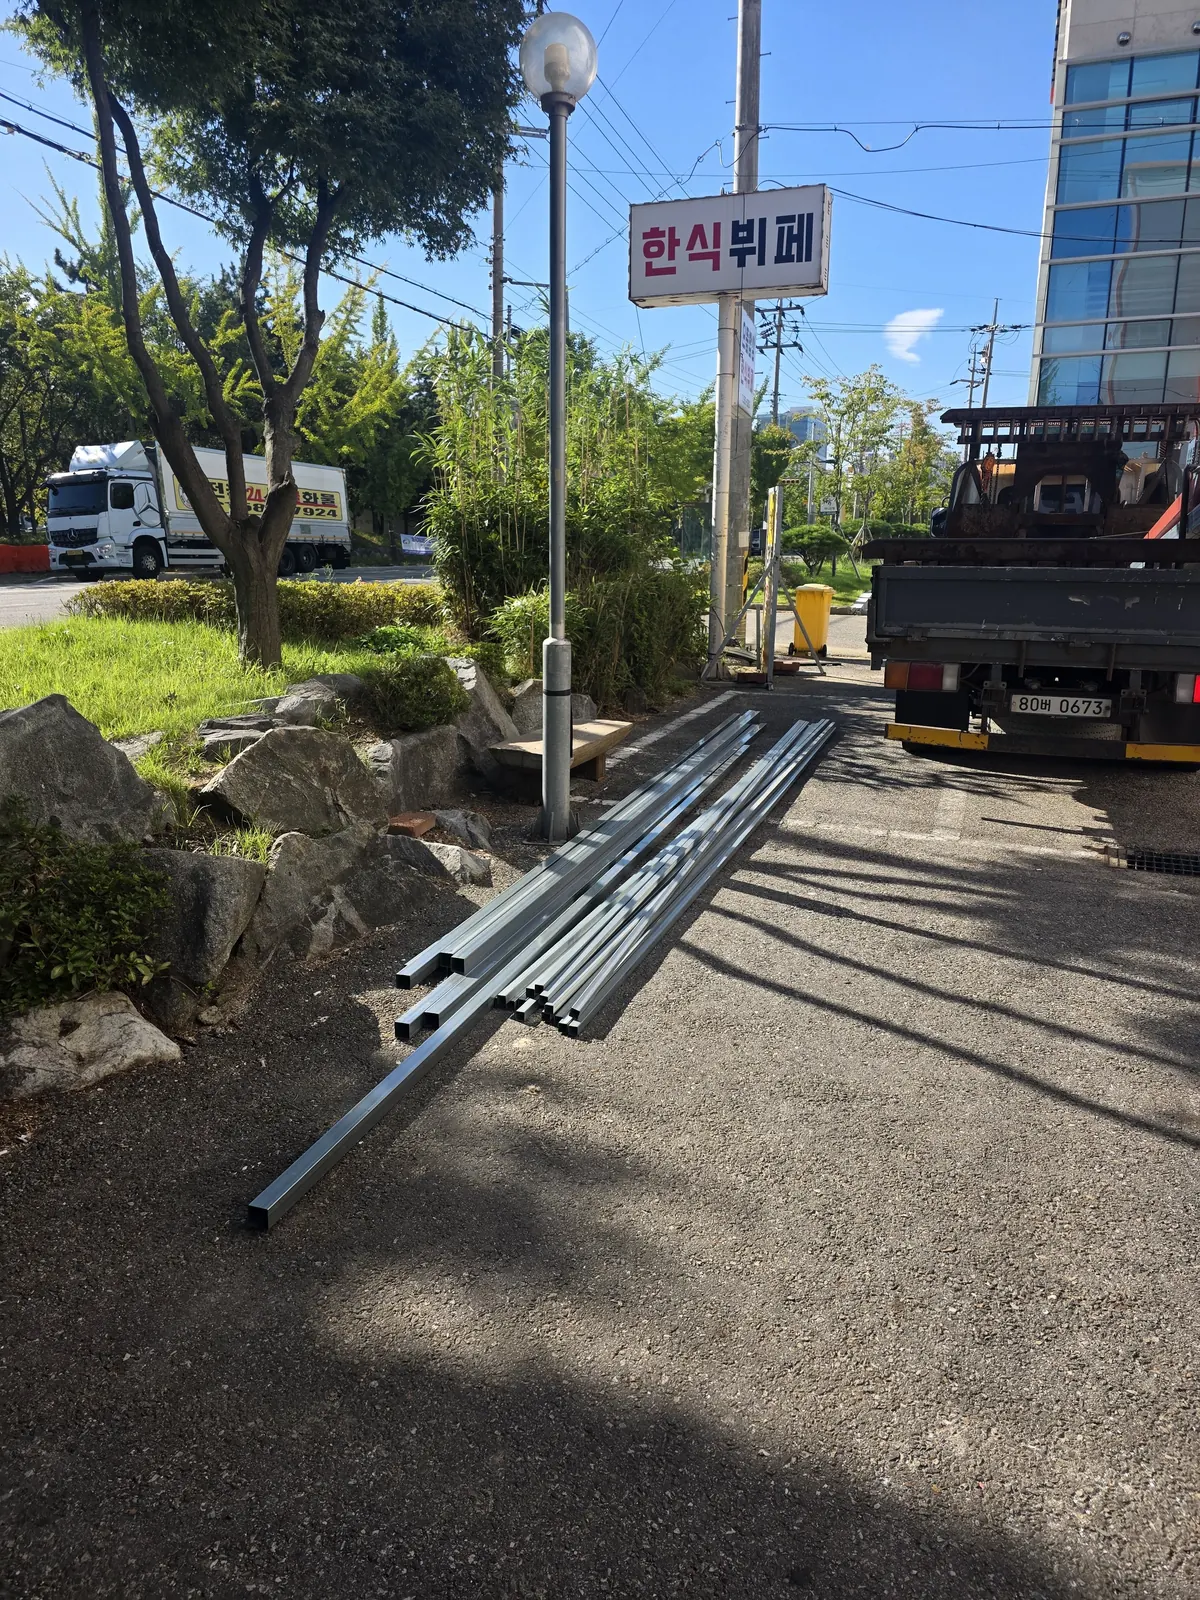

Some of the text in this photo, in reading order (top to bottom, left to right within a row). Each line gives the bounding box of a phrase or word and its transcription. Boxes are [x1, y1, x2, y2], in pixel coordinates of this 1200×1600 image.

[642, 212, 814, 278] 한식뷔페
[1019, 697, 1103, 715] 80버 0673
